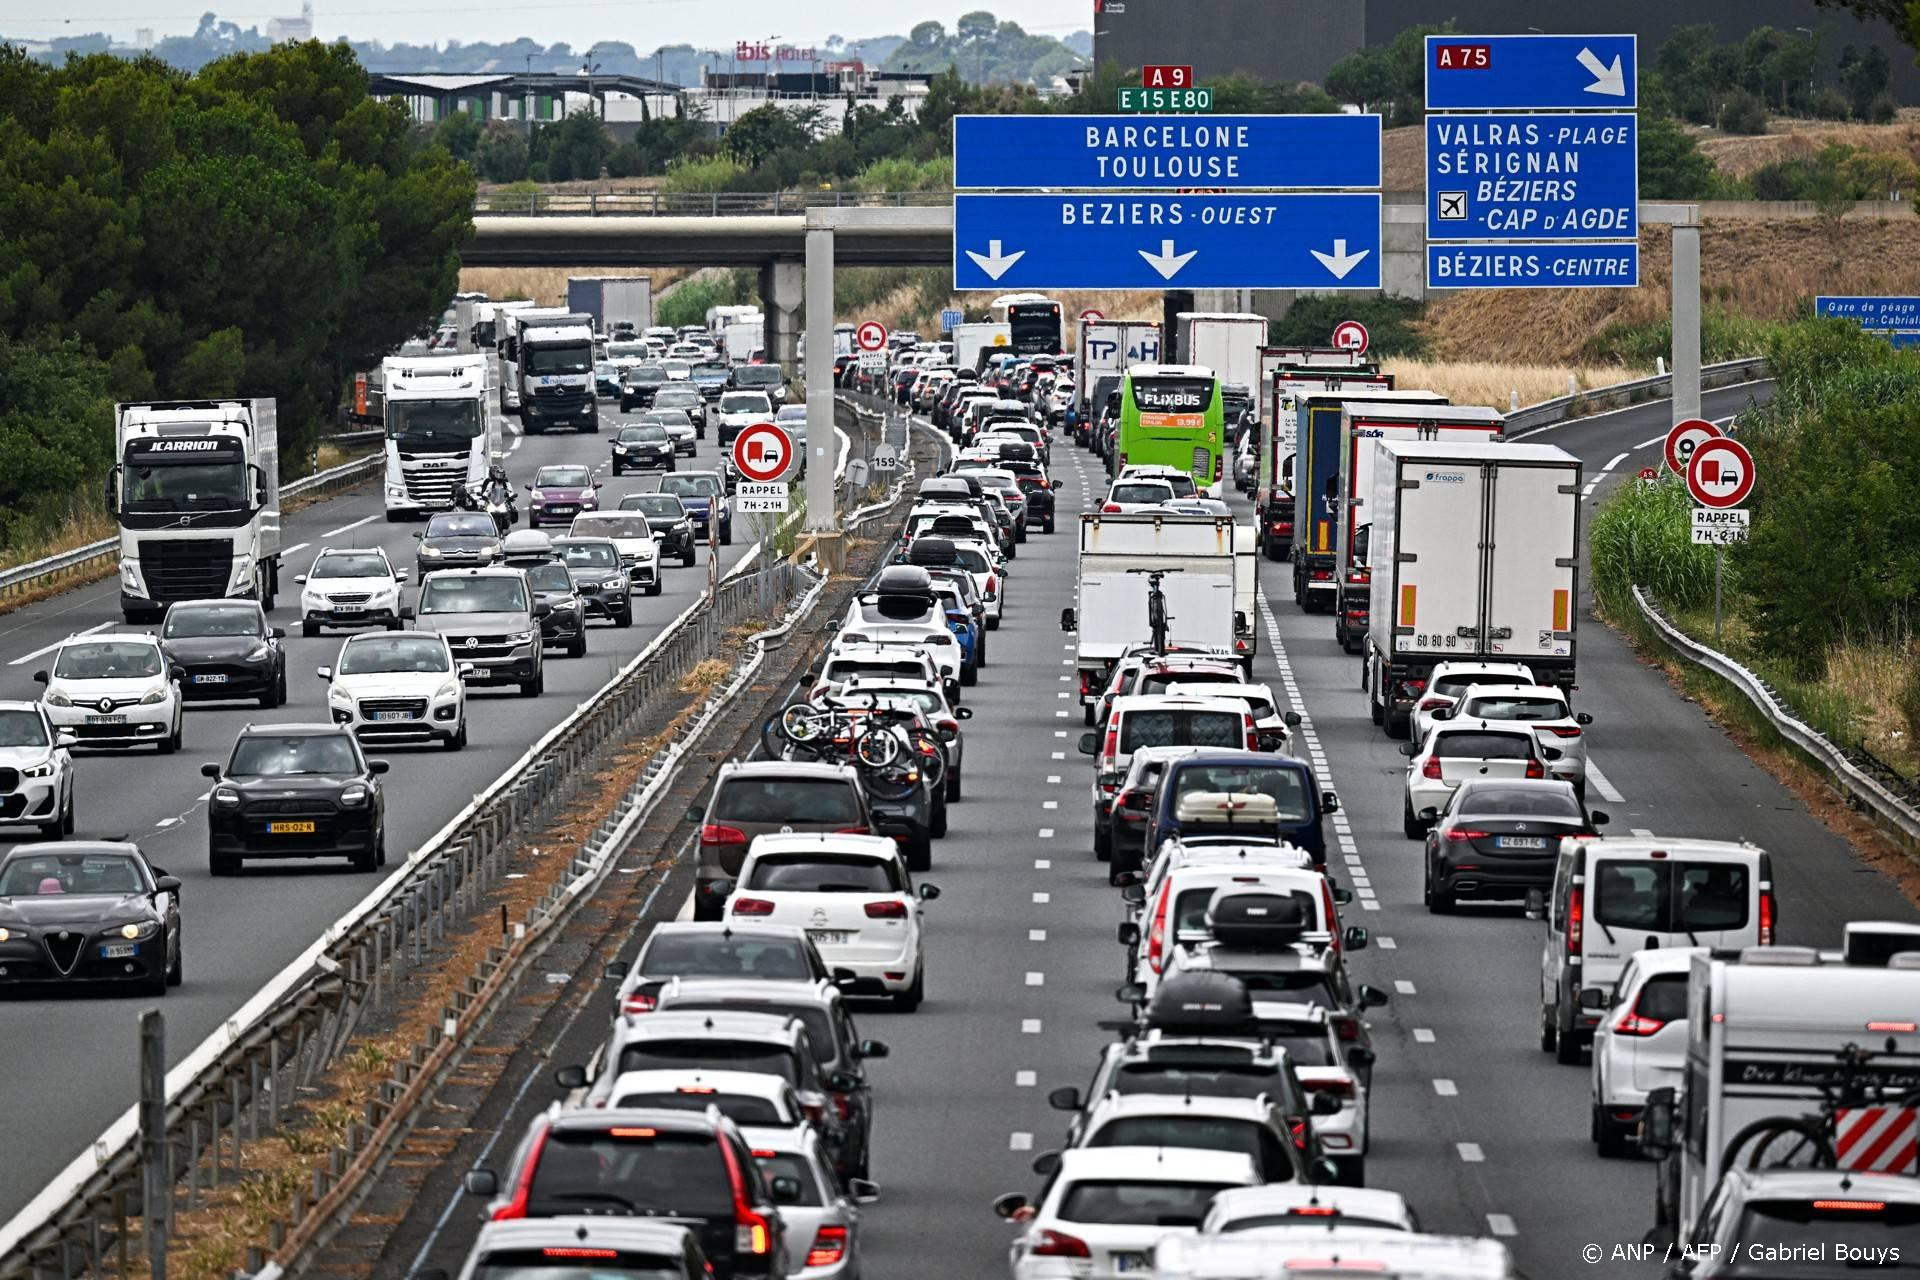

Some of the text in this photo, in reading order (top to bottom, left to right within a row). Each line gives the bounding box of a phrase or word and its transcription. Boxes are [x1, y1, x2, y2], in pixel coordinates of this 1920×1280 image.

[736, 41, 771, 61] ibis
[1440, 48, 1487, 66] A 75
[1152, 69, 1184, 86] A 9
[1121, 91, 1131, 108] E
[1140, 91, 1164, 108] 15
[1086, 126, 1249, 148] BARCELONE
[1437, 124, 1539, 145] VALRAS
[1097, 156, 1239, 178] TOULOUSE
[1437, 149, 1579, 174] SÉRIGNAN
[1476, 175, 1577, 202] BÉZIERS
[1062, 203, 1183, 225] BEZIERS
[1438, 252, 1540, 277] BÉZIERS
[1828, 302, 1915, 314] Gare de péage
[1088, 340, 1117, 361] TP
[875, 457, 895, 467] 159
[1436, 473, 1464, 483] frappa
[742, 486, 782, 494] RAPPEL
[743, 501, 782, 509] 7H-21H
[1697, 512, 1744, 524] RAPPEL
[1417, 634, 1456, 648] 60 80 90
